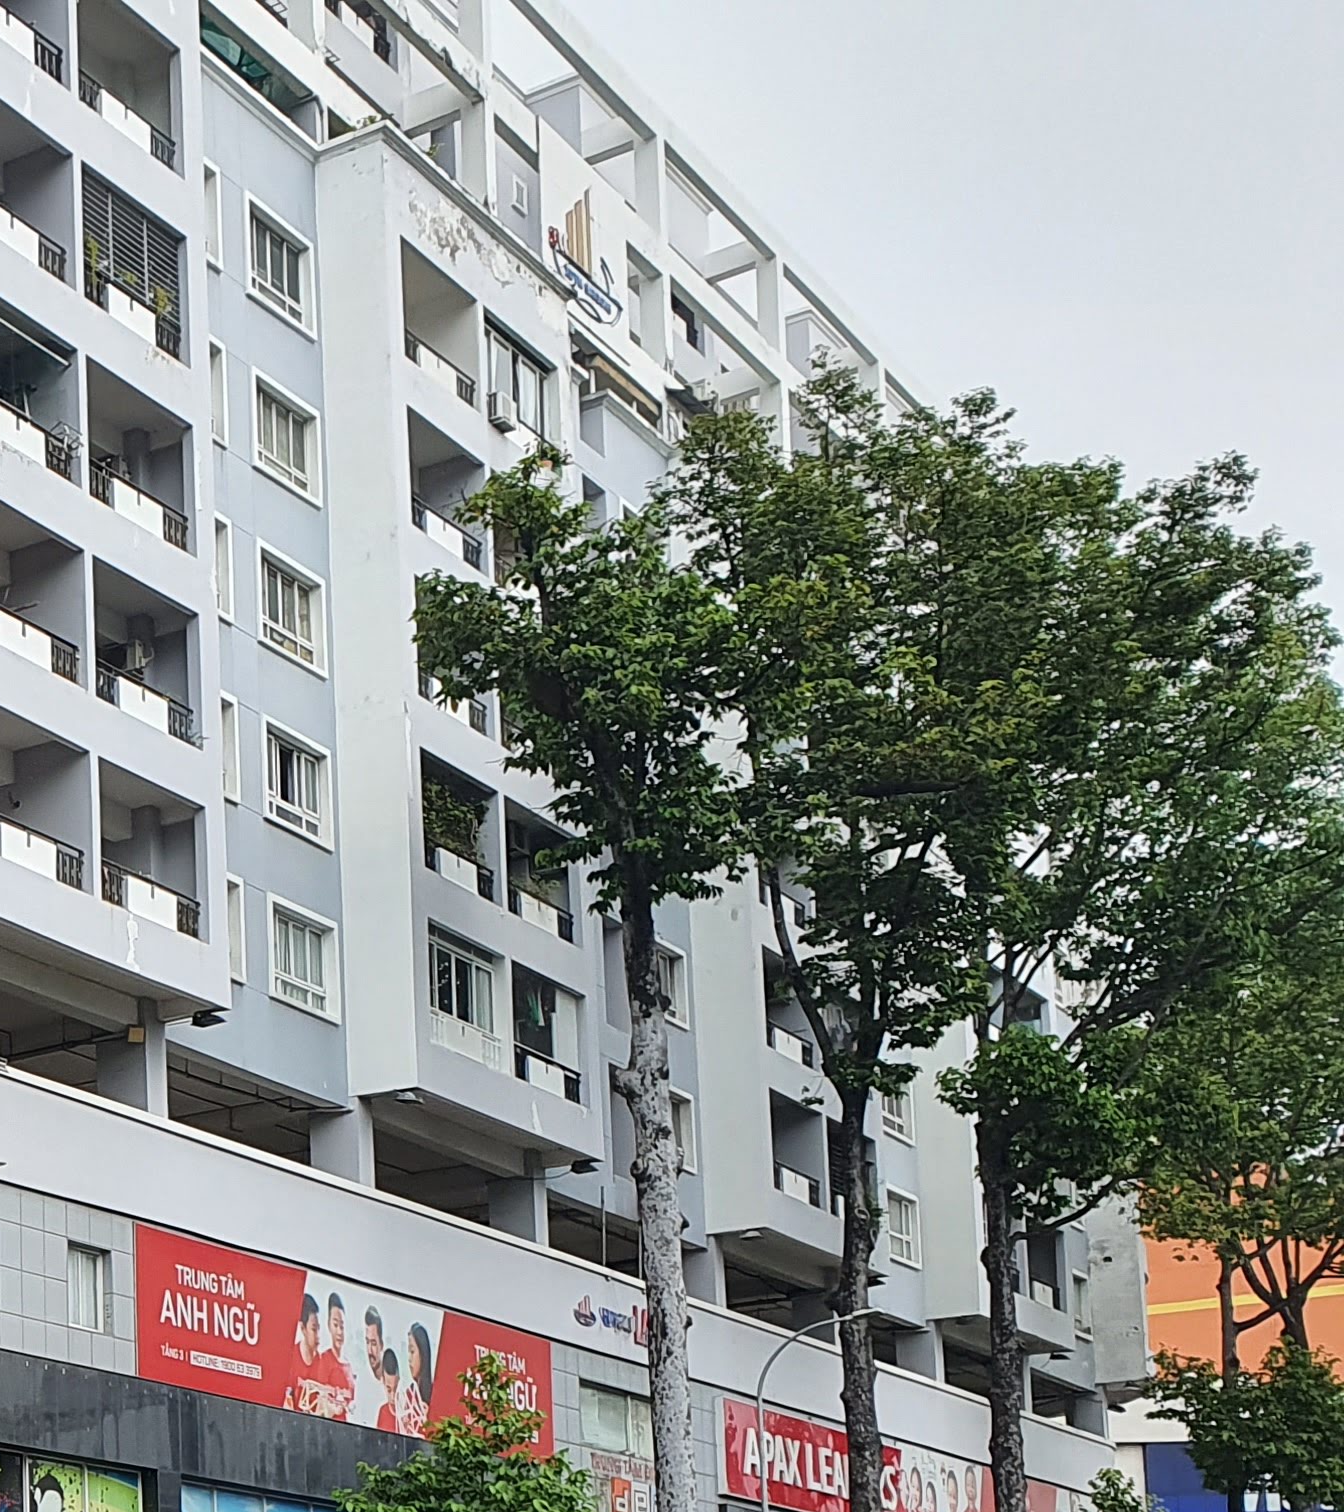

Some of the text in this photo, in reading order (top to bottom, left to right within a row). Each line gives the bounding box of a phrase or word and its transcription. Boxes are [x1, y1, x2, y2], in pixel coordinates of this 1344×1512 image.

[174, 1263, 245, 1301] TRUNG TÂM
[159, 1288, 261, 1346] ANH NGỮ
[743, 1427, 803, 1488] APAX
